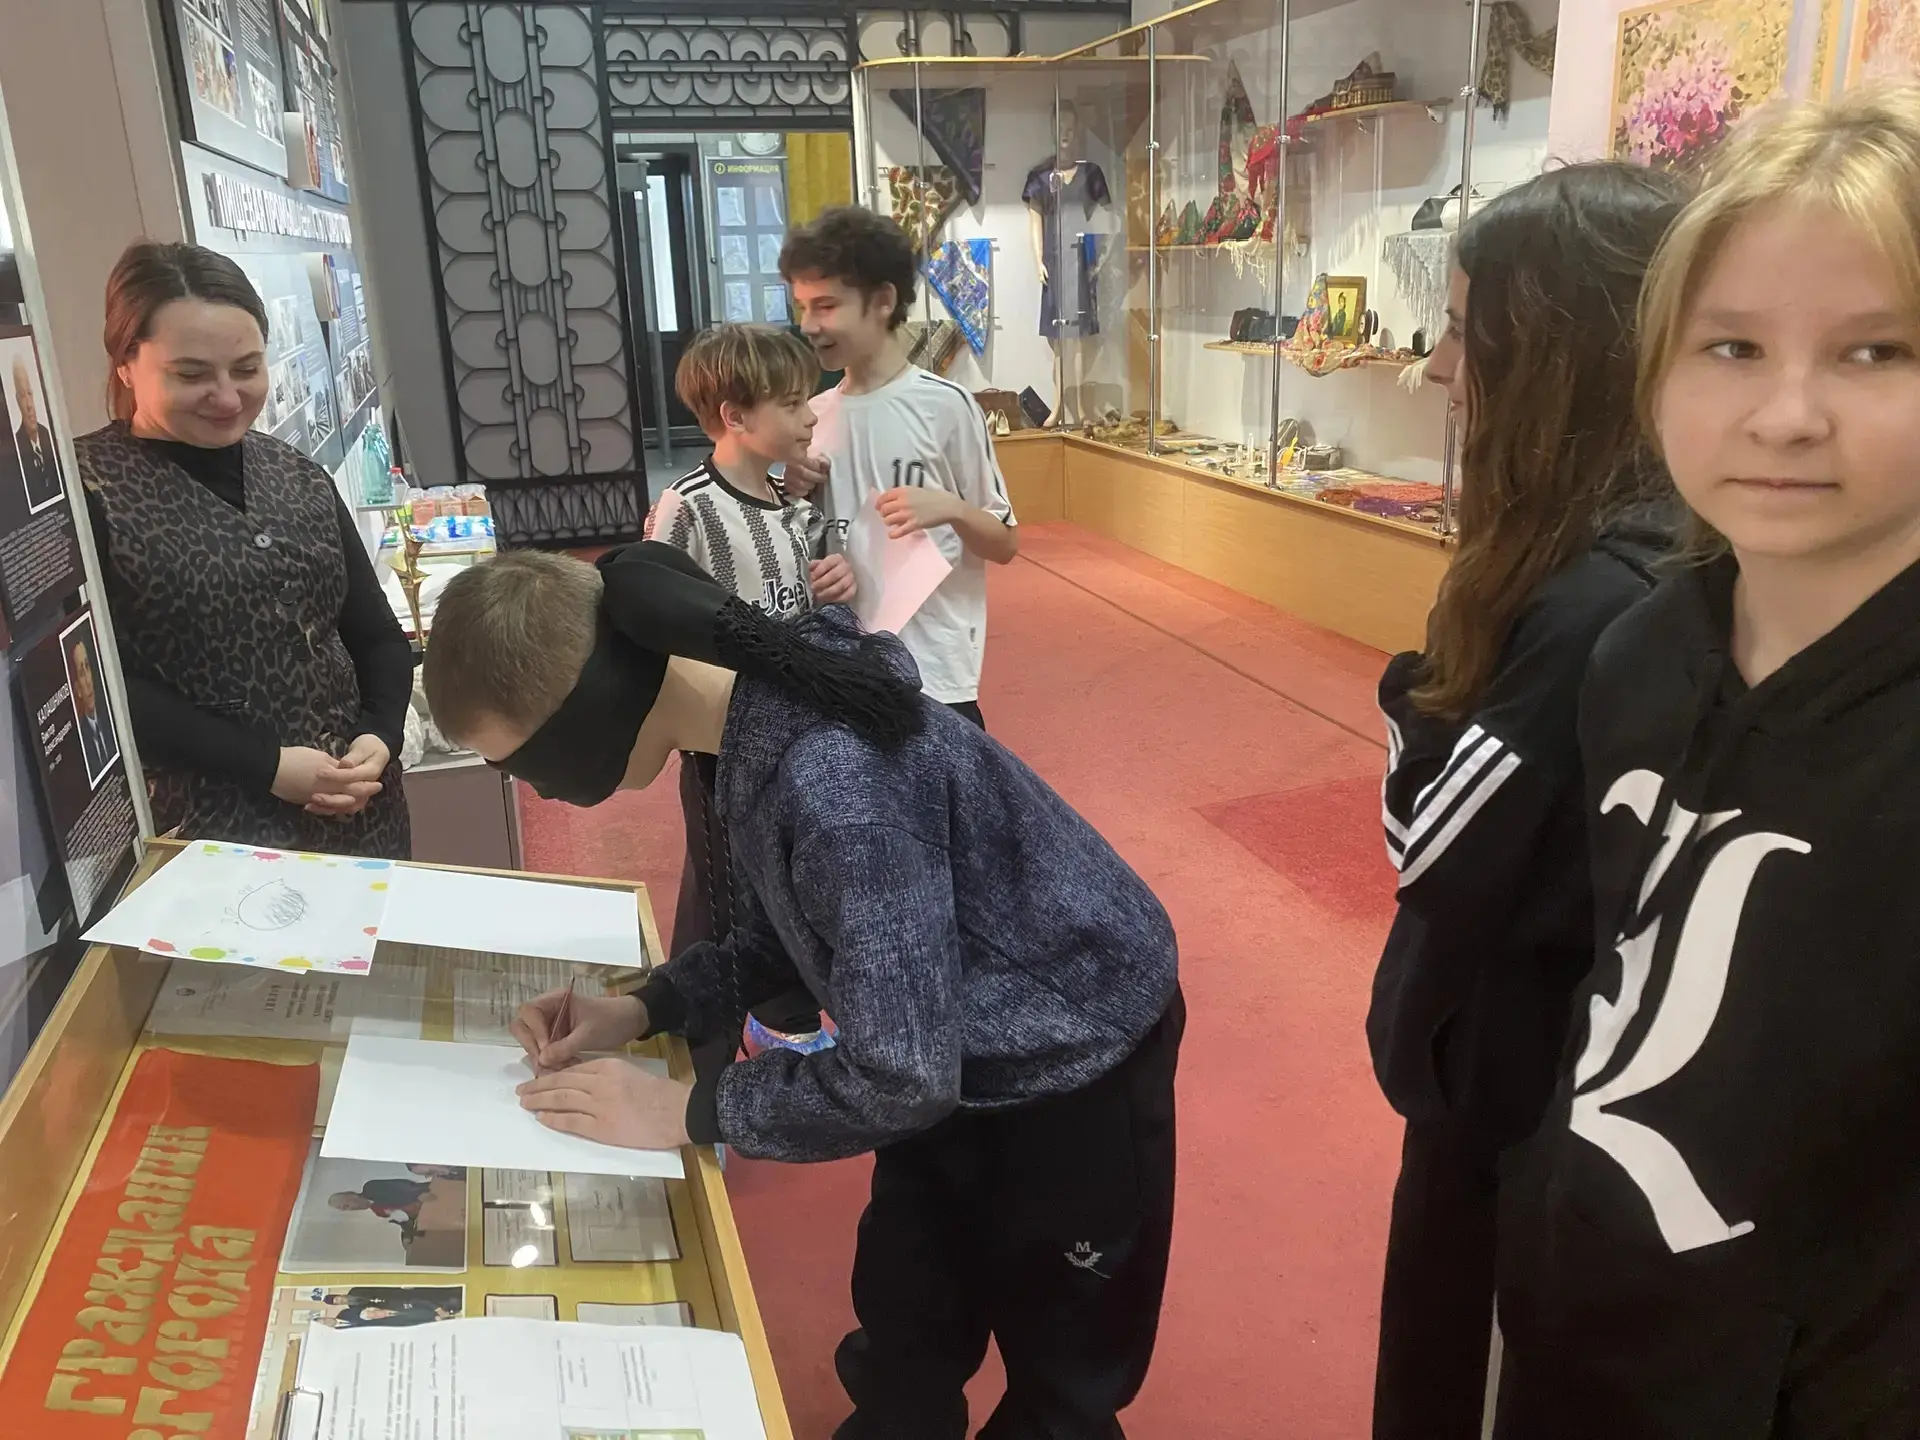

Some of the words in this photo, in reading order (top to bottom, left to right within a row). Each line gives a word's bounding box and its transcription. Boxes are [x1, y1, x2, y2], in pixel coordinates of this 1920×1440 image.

[727, 164, 780, 174] ИНФОРМАЦИЯ
[892, 457, 924, 488] 10
[1075, 1241, 1092, 1253] M
